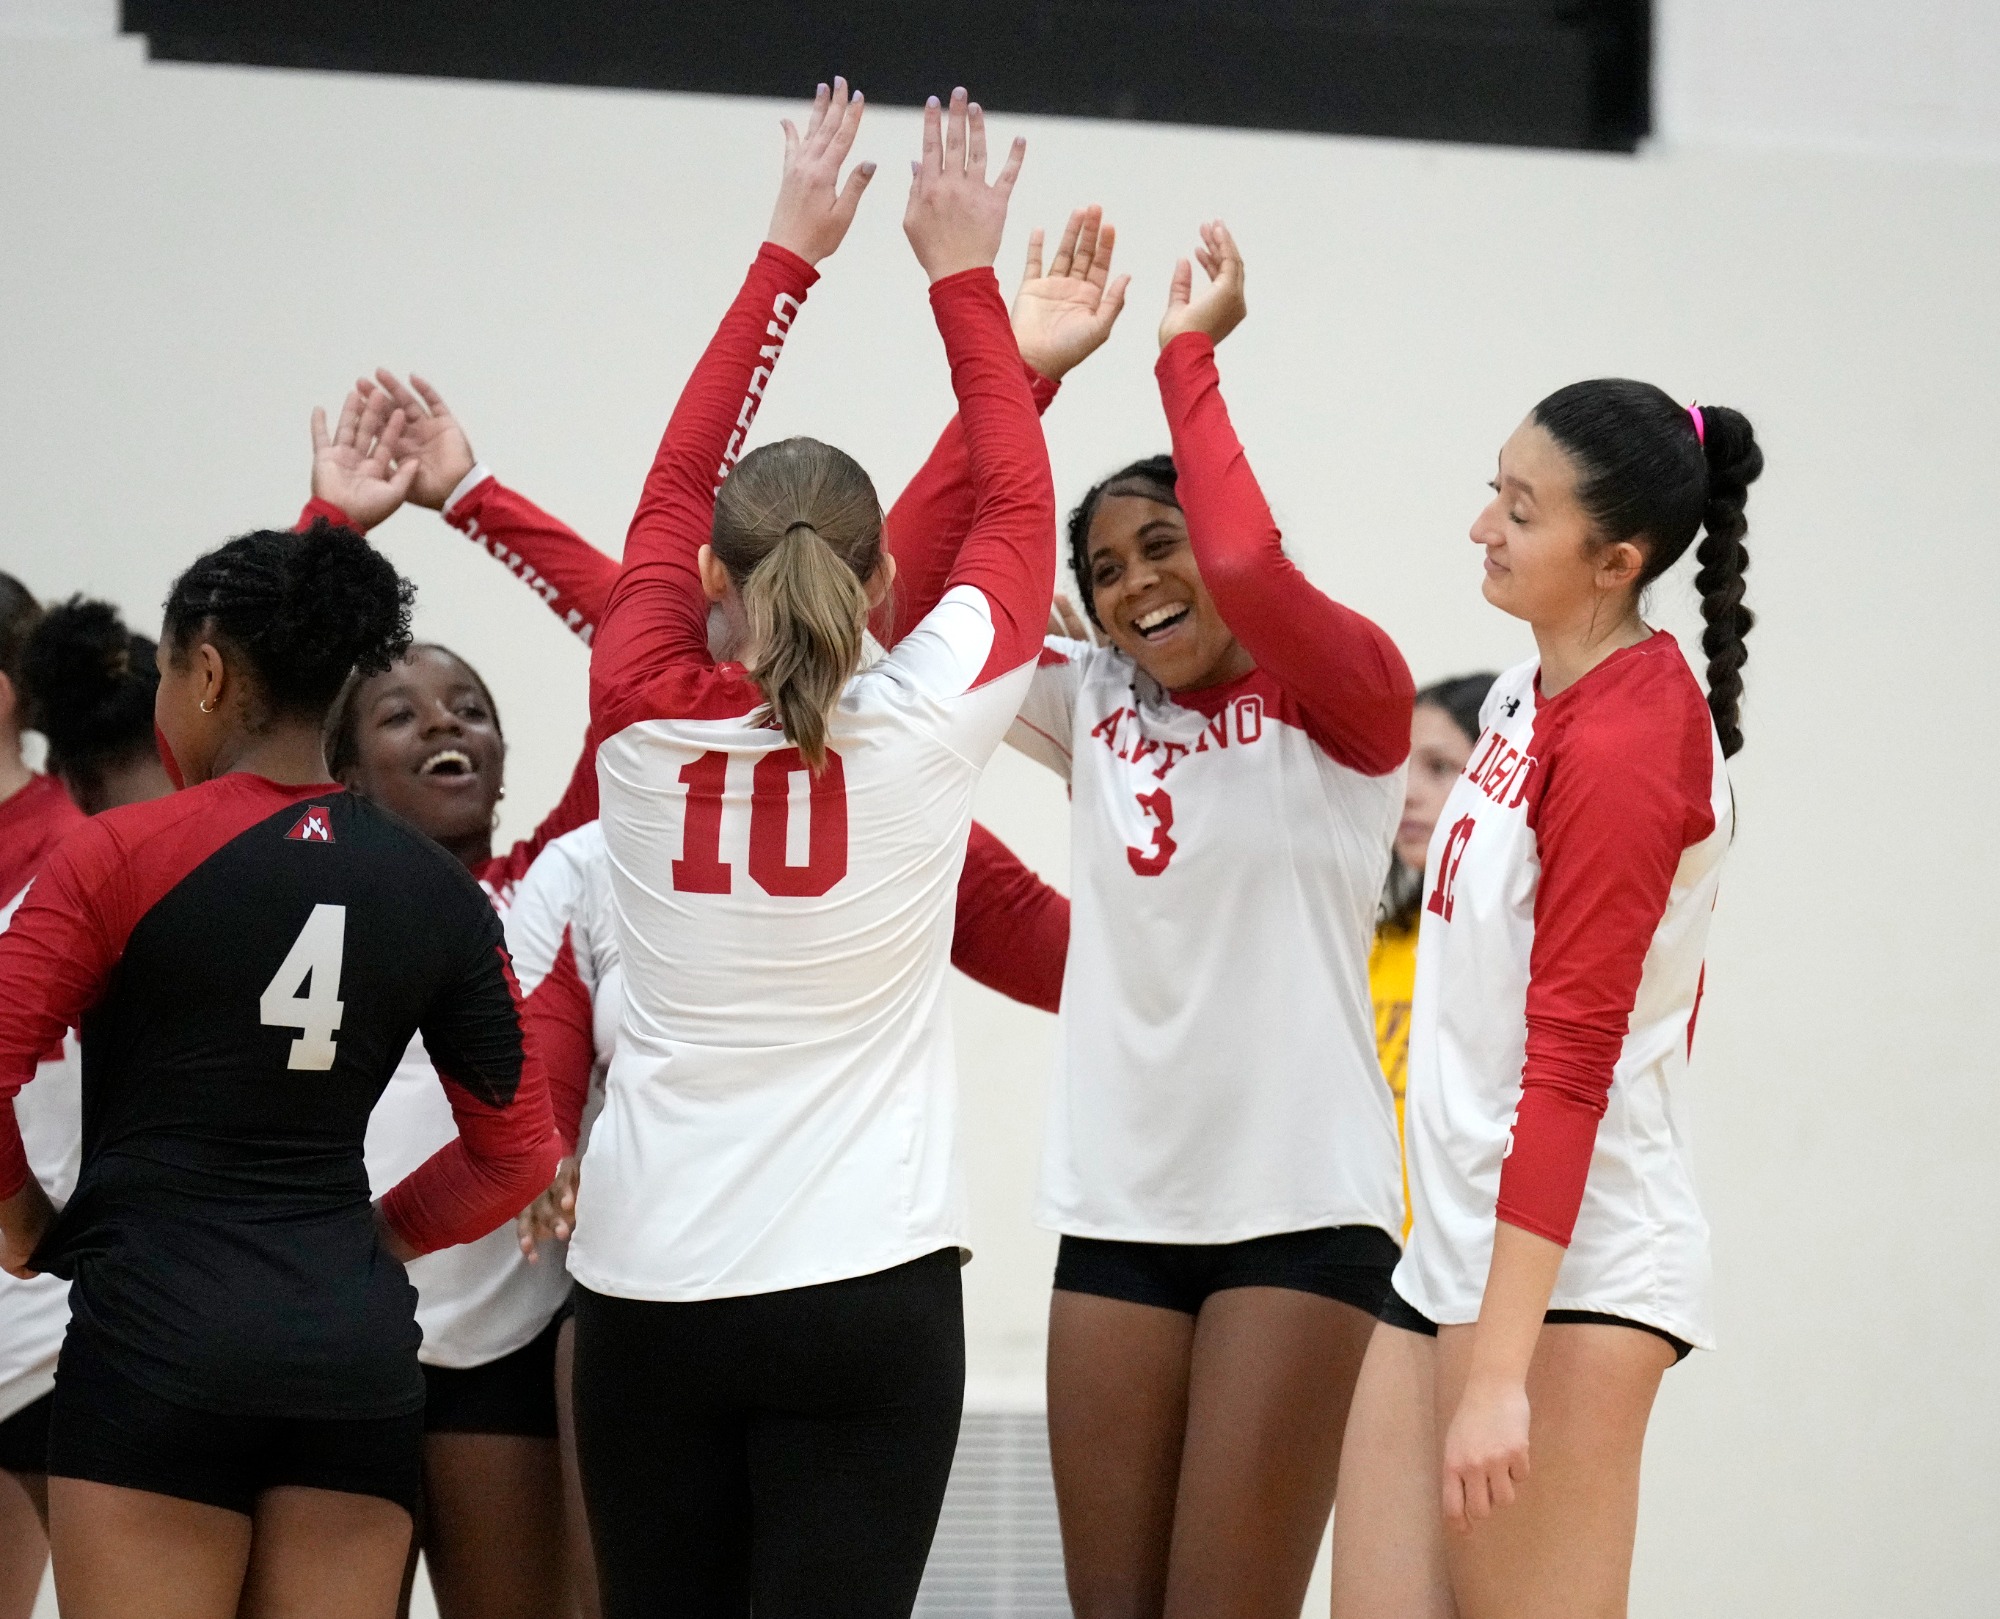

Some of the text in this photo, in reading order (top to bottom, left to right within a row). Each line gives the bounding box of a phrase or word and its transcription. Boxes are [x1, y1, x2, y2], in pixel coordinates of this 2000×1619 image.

[672, 746, 848, 897] 10
[1126, 787, 1178, 877] 3
[1427, 813, 1476, 923] 12
[260, 903, 346, 1071] 4
